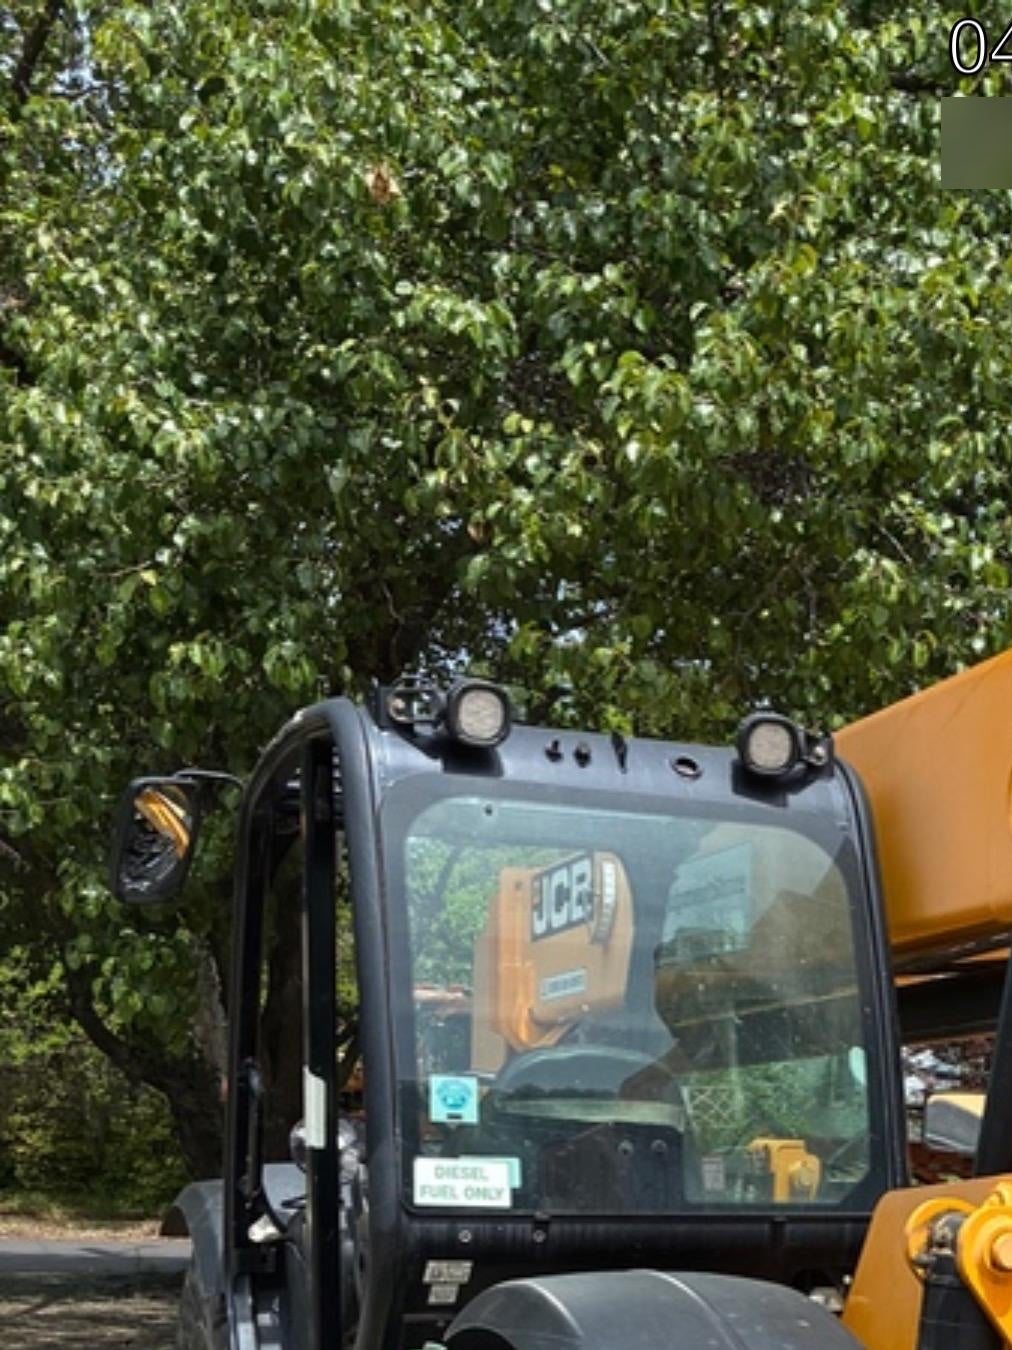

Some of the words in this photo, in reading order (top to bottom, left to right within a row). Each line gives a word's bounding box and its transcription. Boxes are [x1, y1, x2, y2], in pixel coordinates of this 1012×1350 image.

[533, 856, 593, 936] JCB
[433, 1164, 489, 1183] DIESEL
[419, 1184, 459, 1201] FUEL
[463, 1184, 505, 1201] ONLY
